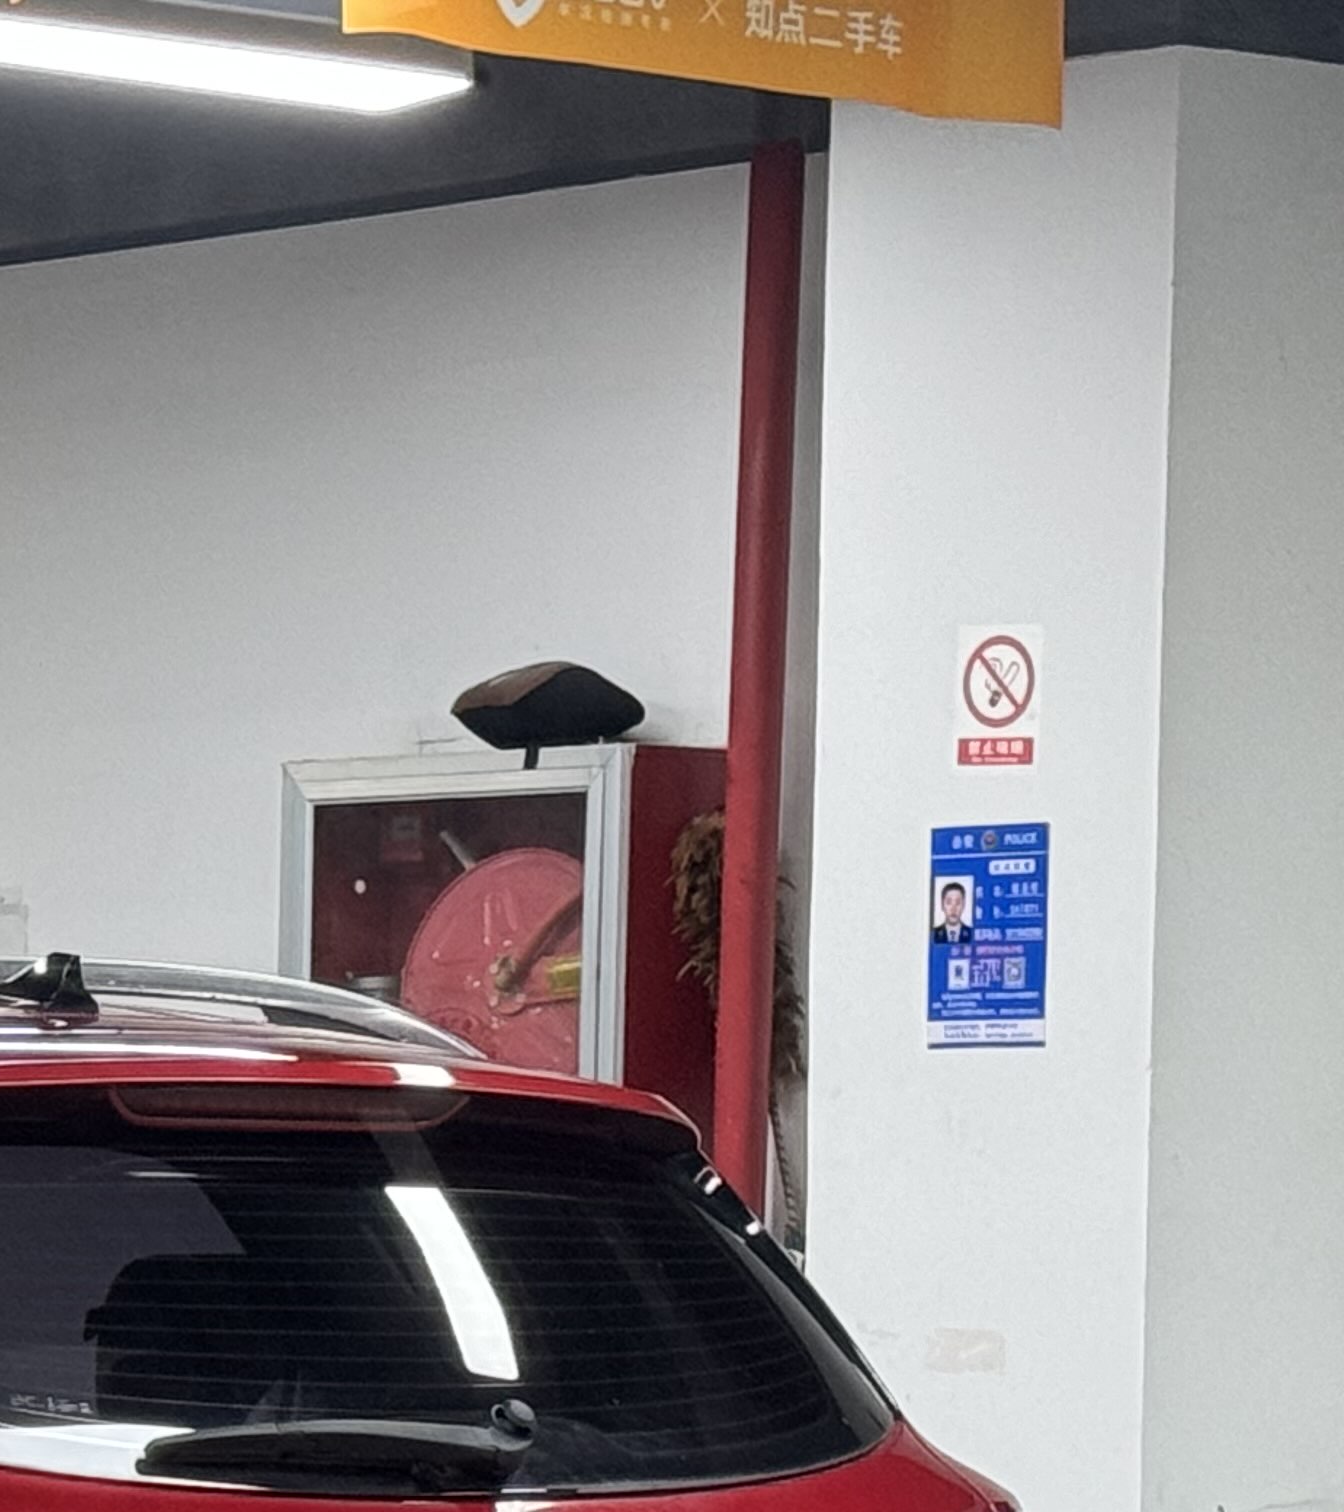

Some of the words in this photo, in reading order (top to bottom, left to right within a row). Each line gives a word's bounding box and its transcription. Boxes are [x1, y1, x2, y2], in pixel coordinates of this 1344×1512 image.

[745, 0, 904, 60] 知点二手车
